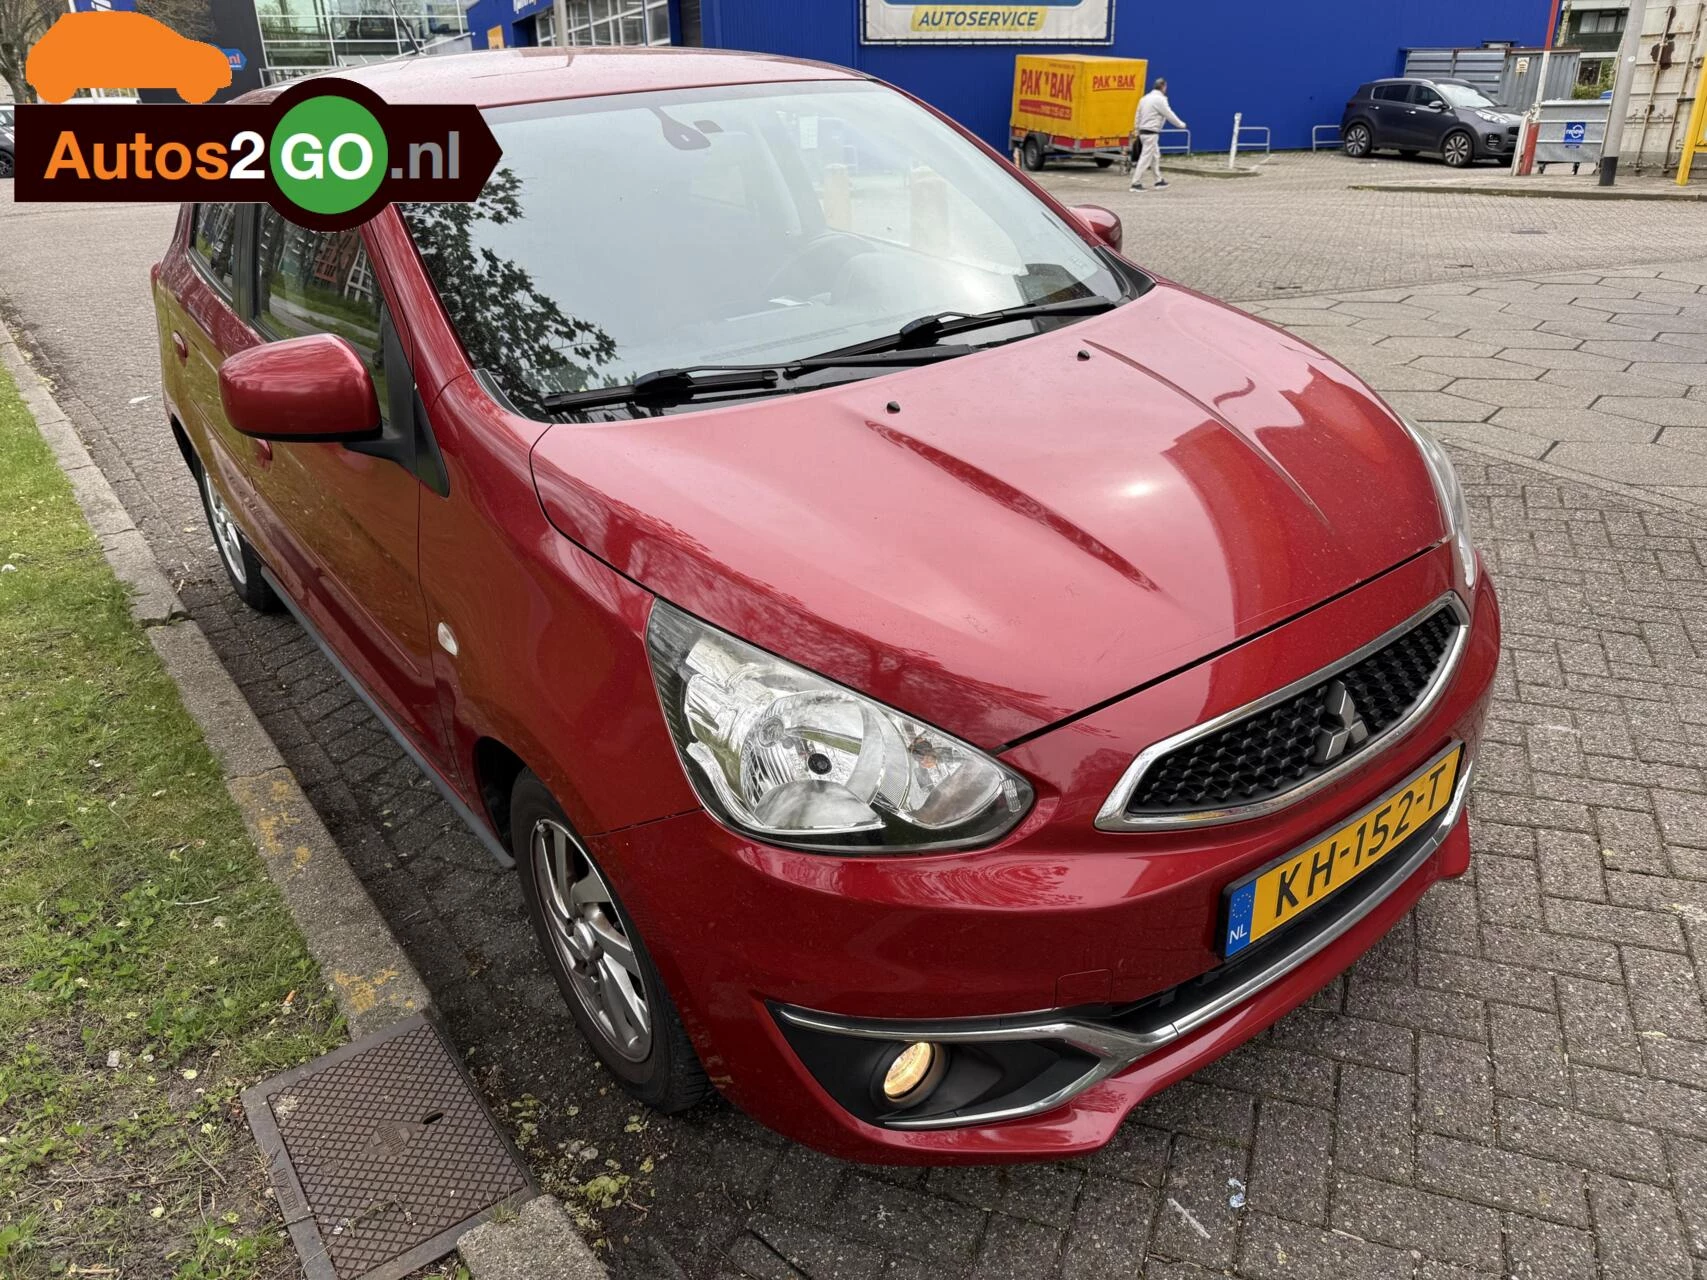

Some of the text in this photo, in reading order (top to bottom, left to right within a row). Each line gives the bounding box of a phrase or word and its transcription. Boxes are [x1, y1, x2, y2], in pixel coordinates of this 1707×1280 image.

[918, 11, 1039, 27] AUTOSERVICE
[1020, 68, 1042, 96] PAK
[1050, 72, 1074, 103] BAK
[1092, 75, 1111, 89] PAK
[1117, 74, 1136, 88] BAK
[1275, 763, 1447, 919] KH-152-T
[1229, 923, 1248, 945] NL
